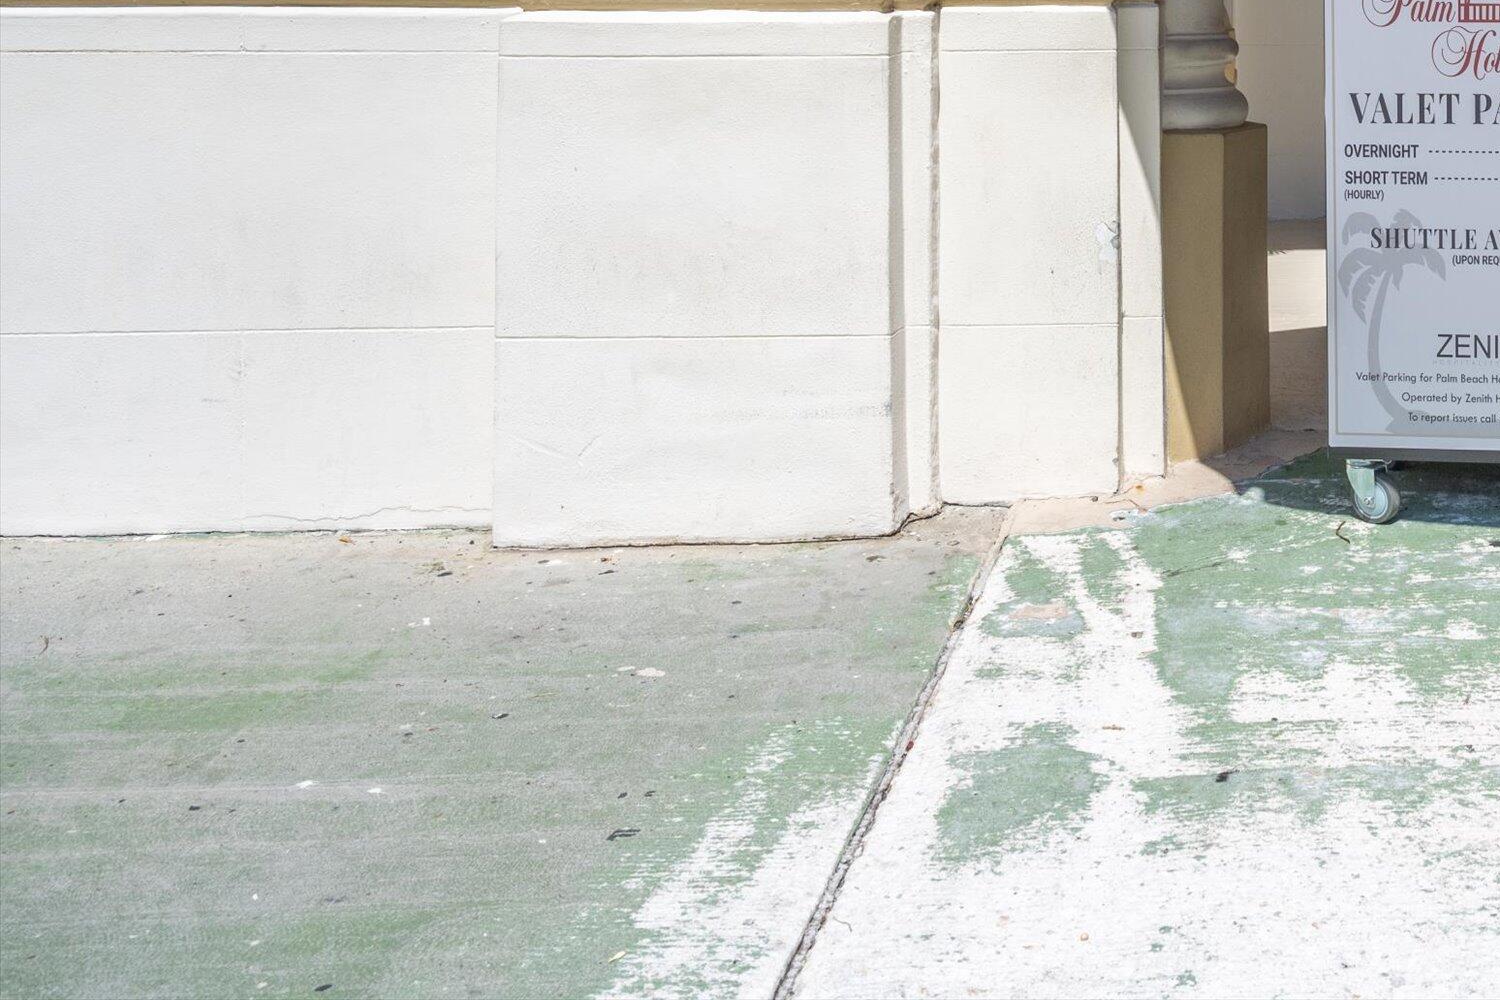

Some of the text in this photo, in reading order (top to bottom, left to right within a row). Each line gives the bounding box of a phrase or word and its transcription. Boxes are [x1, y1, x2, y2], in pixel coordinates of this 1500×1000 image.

[1349, 92, 1460, 125] VALET
[1344, 144, 1419, 158] OVERNIGHT
[1345, 171, 1390, 185] SHORT
[1391, 171, 1428, 185] TERM
[1344, 190, 1385, 201] (HOURLY)
[1370, 227, 1477, 250] SHUTTLE
[1452, 255, 1480, 267] (UPON
[1355, 372, 1379, 382] Valet
[1382, 372, 1416, 385] Parking
[1419, 372, 1432, 383] for
[1436, 373, 1458, 383] Palm
[1460, 373, 1488, 384] Beach
[1401, 392, 1447, 405] Operated
[1450, 393, 1462, 405] by
[1465, 393, 1492, 404] Zenith
[1408, 412, 1418, 422] To
[1421, 412, 1449, 424] report
[1452, 413, 1477, 423] issues
[1480, 413, 1496, 423] call
